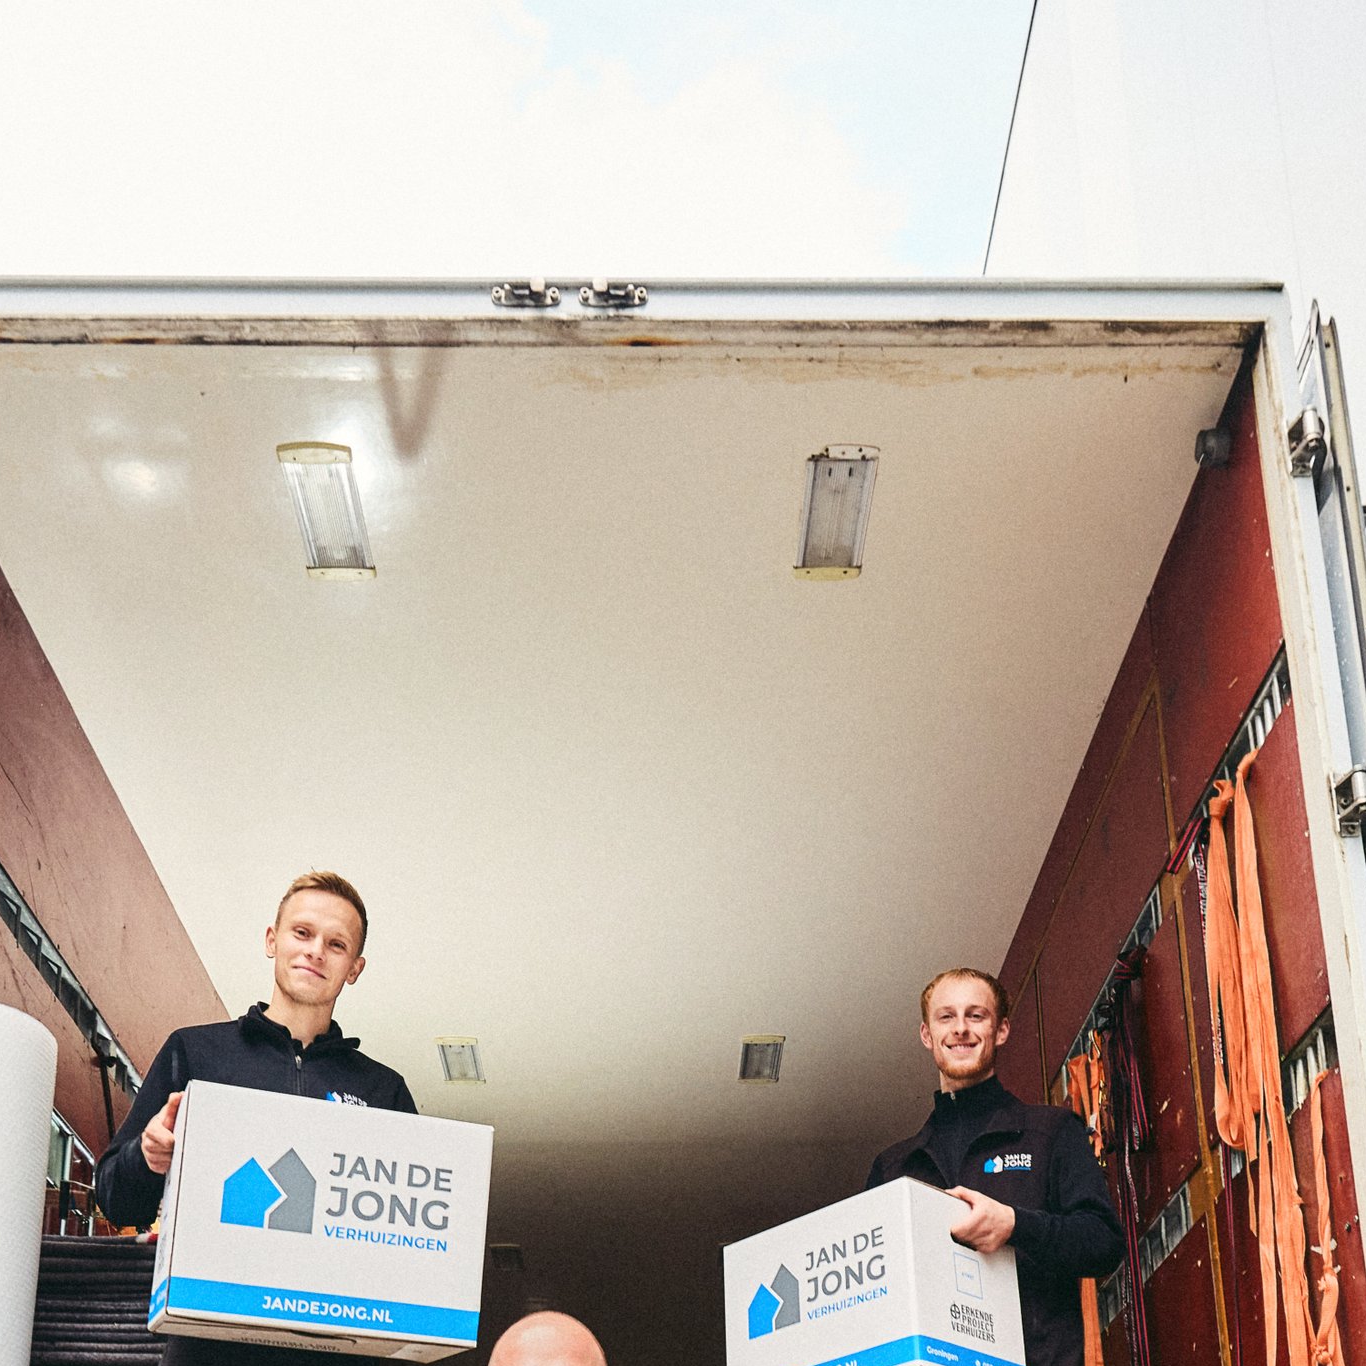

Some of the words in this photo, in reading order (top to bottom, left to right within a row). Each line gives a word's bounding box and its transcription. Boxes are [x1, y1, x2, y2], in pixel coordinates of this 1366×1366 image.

[329, 1152, 397, 1185] JAN
[407, 1164, 453, 1192] DE
[1003, 1160, 1032, 1168] JONG
[325, 1186, 450, 1231] JONG
[324, 1224, 448, 1252] VERHUIZINGEN
[805, 1240, 847, 1271] JAN
[853, 1226, 884, 1254] DE
[806, 1254, 886, 1302] JONG
[262, 1295, 394, 1324] JANDEJONG.NL
[807, 1285, 888, 1320] VERHUIZINGEN
[960, 1304, 994, 1324] ERKENDE
[951, 1320, 996, 1344] VERHUIZERS
[962, 1315, 994, 1333] PROJECT
[926, 1345, 959, 1362] Groningen
